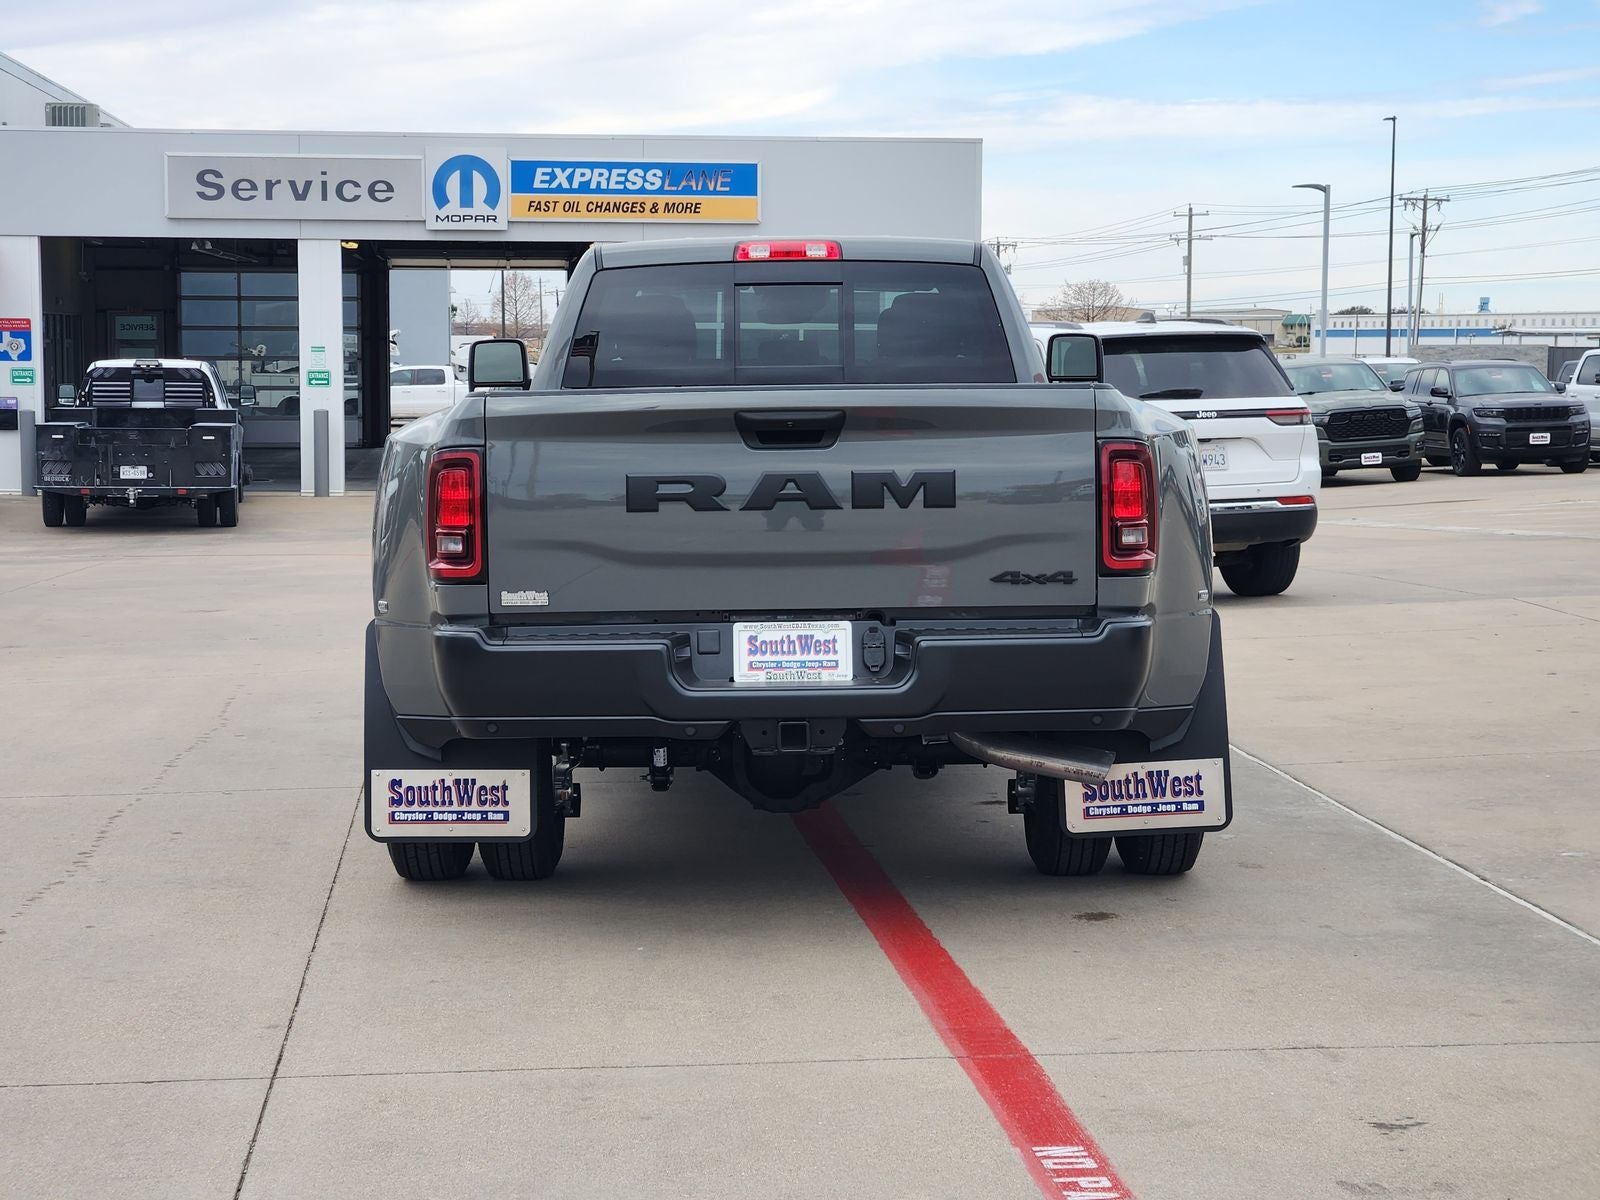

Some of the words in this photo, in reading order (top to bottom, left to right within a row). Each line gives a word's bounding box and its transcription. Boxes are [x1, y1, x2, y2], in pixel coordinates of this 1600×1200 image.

[196, 168, 395, 203] Service
[527, 200, 558, 214] FAST
[563, 200, 582, 214] OIL
[586, 201, 646, 214] CHANGES
[649, 201, 660, 214] &
[664, 202, 702, 215] MORE
[435, 214, 498, 223] MOPAR
[1202, 454, 1225, 465] W943
[626, 469, 956, 512] RAM
[989, 570, 1078, 585] 4x4
[747, 634, 838, 656] SouthWest
[752, 661, 777, 669] Chrysler
[765, 671, 822, 680] SouthWest
[388, 778, 510, 808] SouthWest
[1082, 769, 1204, 803] SouthWest
[394, 812, 426, 821] Chrysler
[433, 812, 457, 821] Dodge
[462, 812, 481, 821] Jeep
[488, 812, 504, 820] Ram
[1089, 806, 1121, 816] Chrysler
[1127, 805, 1151, 814] Dodge
[1157, 804, 1175, 813] Jeep
[1183, 802, 1198, 810] Ram
[1031, 1146, 1099, 1169] NO
